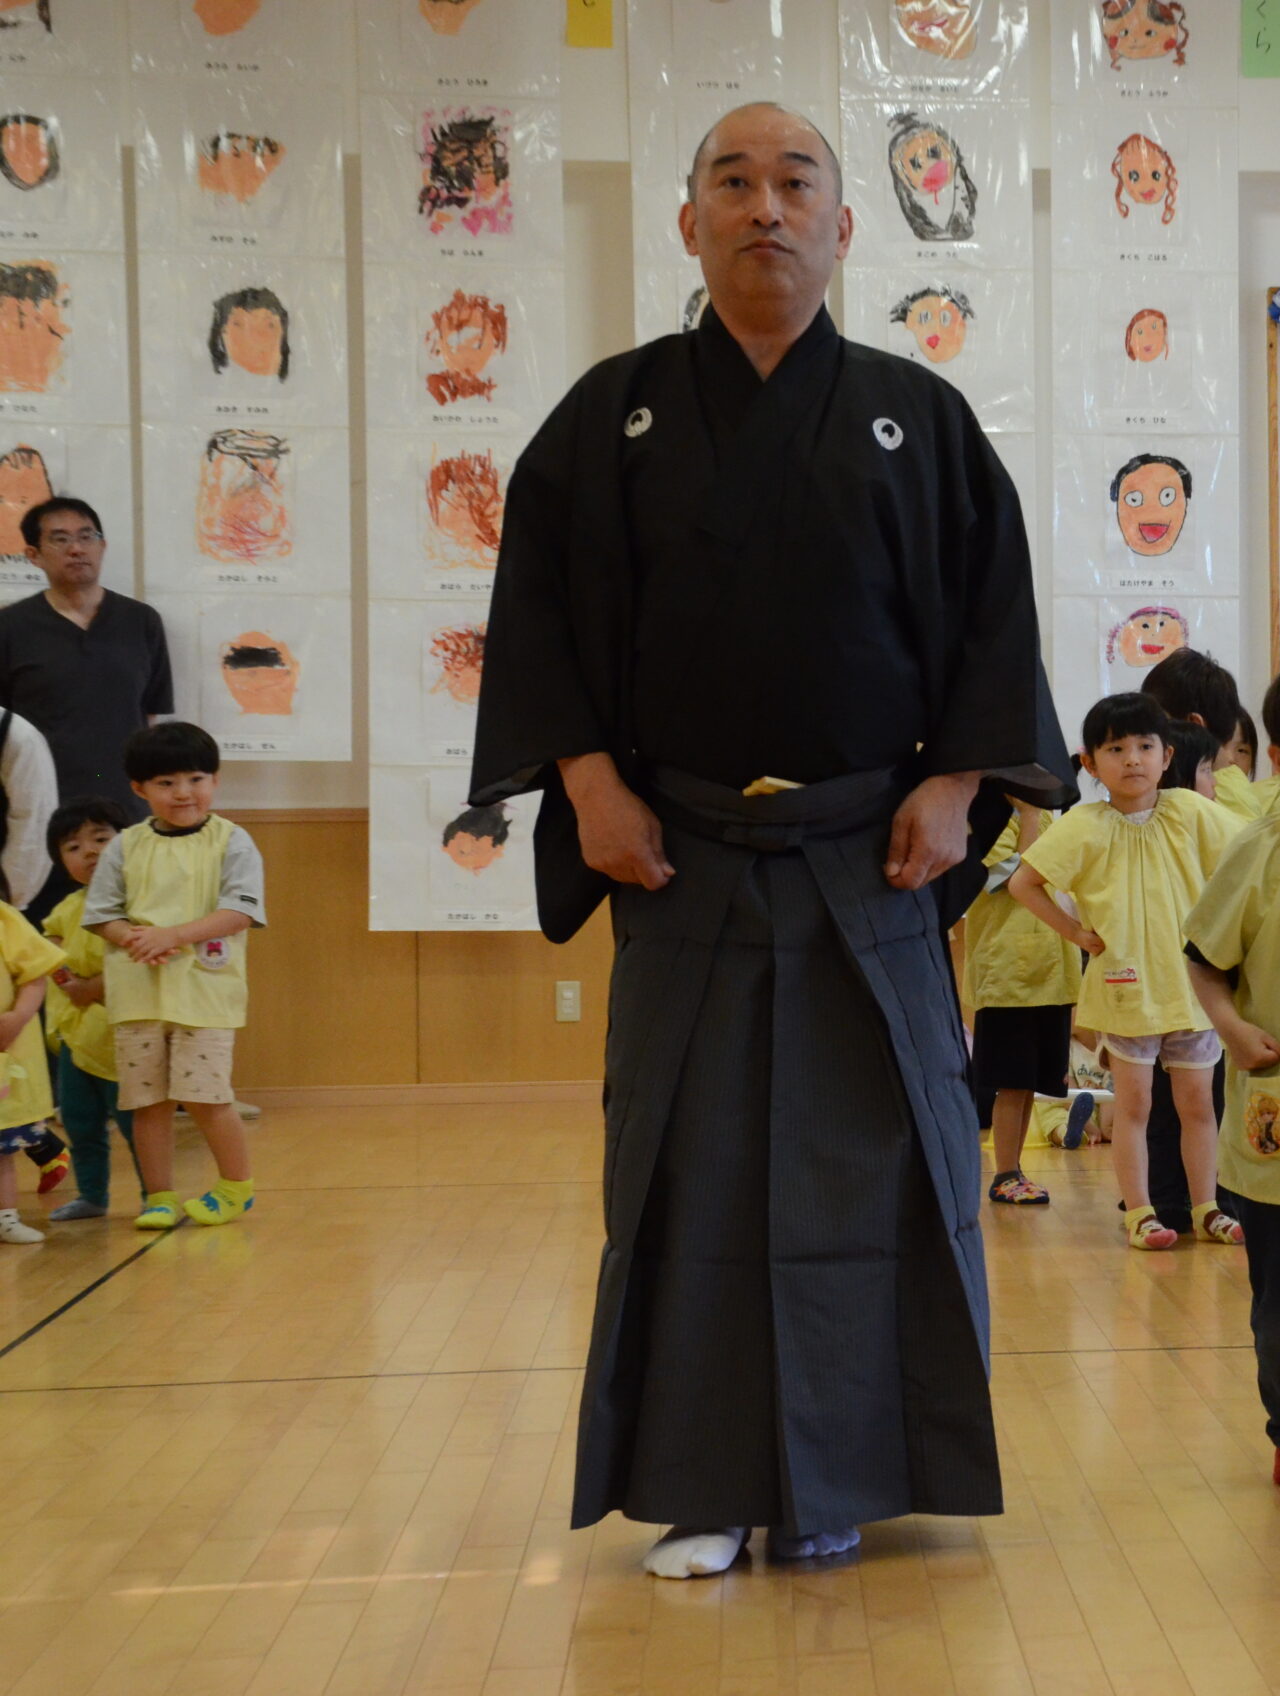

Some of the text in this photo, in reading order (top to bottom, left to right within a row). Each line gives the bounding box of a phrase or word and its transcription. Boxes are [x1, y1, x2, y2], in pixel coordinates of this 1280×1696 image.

[469, 416, 499, 424] しょうた
[218, 575, 248, 585] たかはし
[1162, 580, 1174, 589] そう
[446, 913, 476, 923] たかはし
